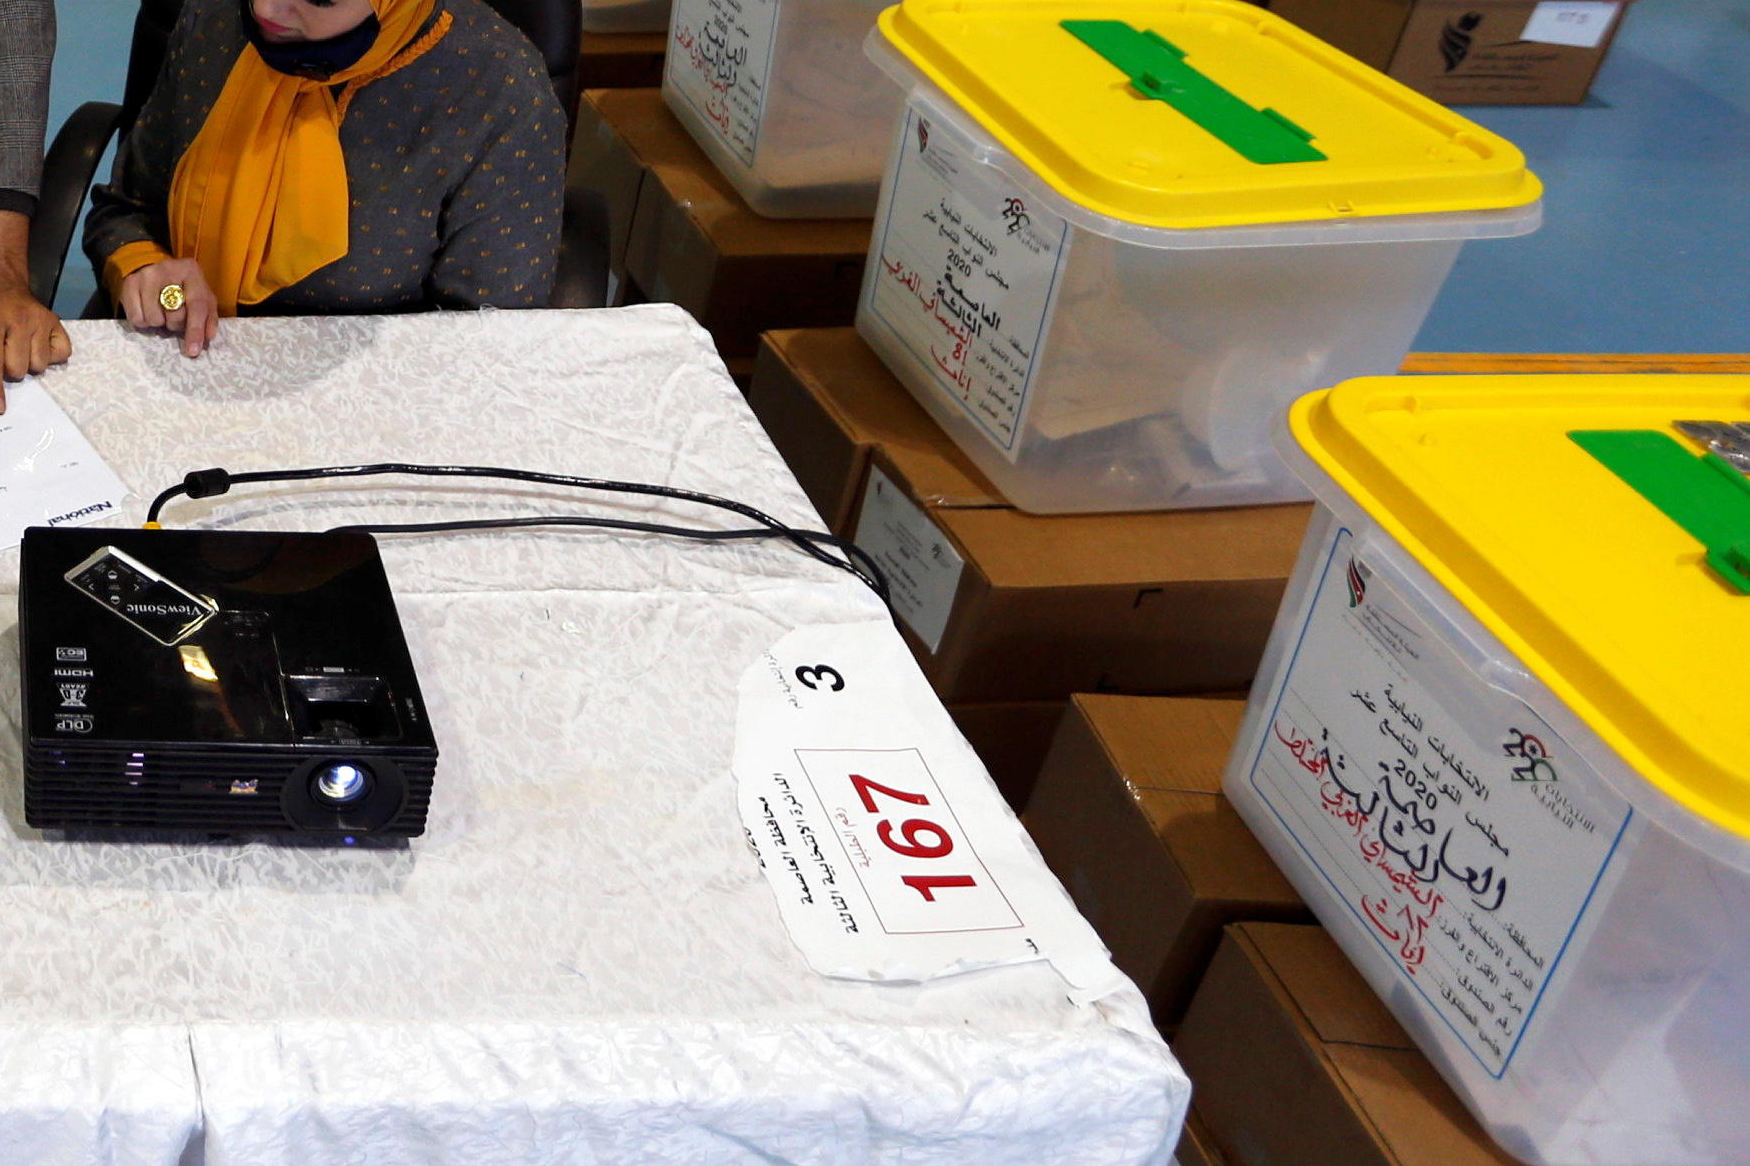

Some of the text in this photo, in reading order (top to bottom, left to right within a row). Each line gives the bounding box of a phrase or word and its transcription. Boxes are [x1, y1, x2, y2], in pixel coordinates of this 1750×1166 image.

[947, 248, 971, 278] 2020
[944, 264, 1001, 331] العاصمة
[47, 501, 112, 527] National
[126, 603, 202, 615] ViewSonic
[54, 668, 93, 677] HDMI
[795, 664, 845, 692] 3
[1350, 690, 1377, 713] عشر
[56, 719, 93, 732] DLP
[1379, 718, 1419, 758] التاسع
[1383, 683, 1489, 801] الانتخابات النيابية
[1321, 727, 1439, 882] الثالثة
[1393, 759, 1438, 810] 2020
[1423, 761, 1462, 805] النواب
[835, 807, 857, 828] رقم
[848, 774, 977, 902] 167
[1378, 760, 1506, 911] العاصمة
[1465, 811, 1509, 857] مجلس
[758, 796, 813, 905] محافظة العاصمة
[773, 773, 859, 934] الدائرة الإنتخابية الثالثة
[1361, 895, 1425, 976] إناث
